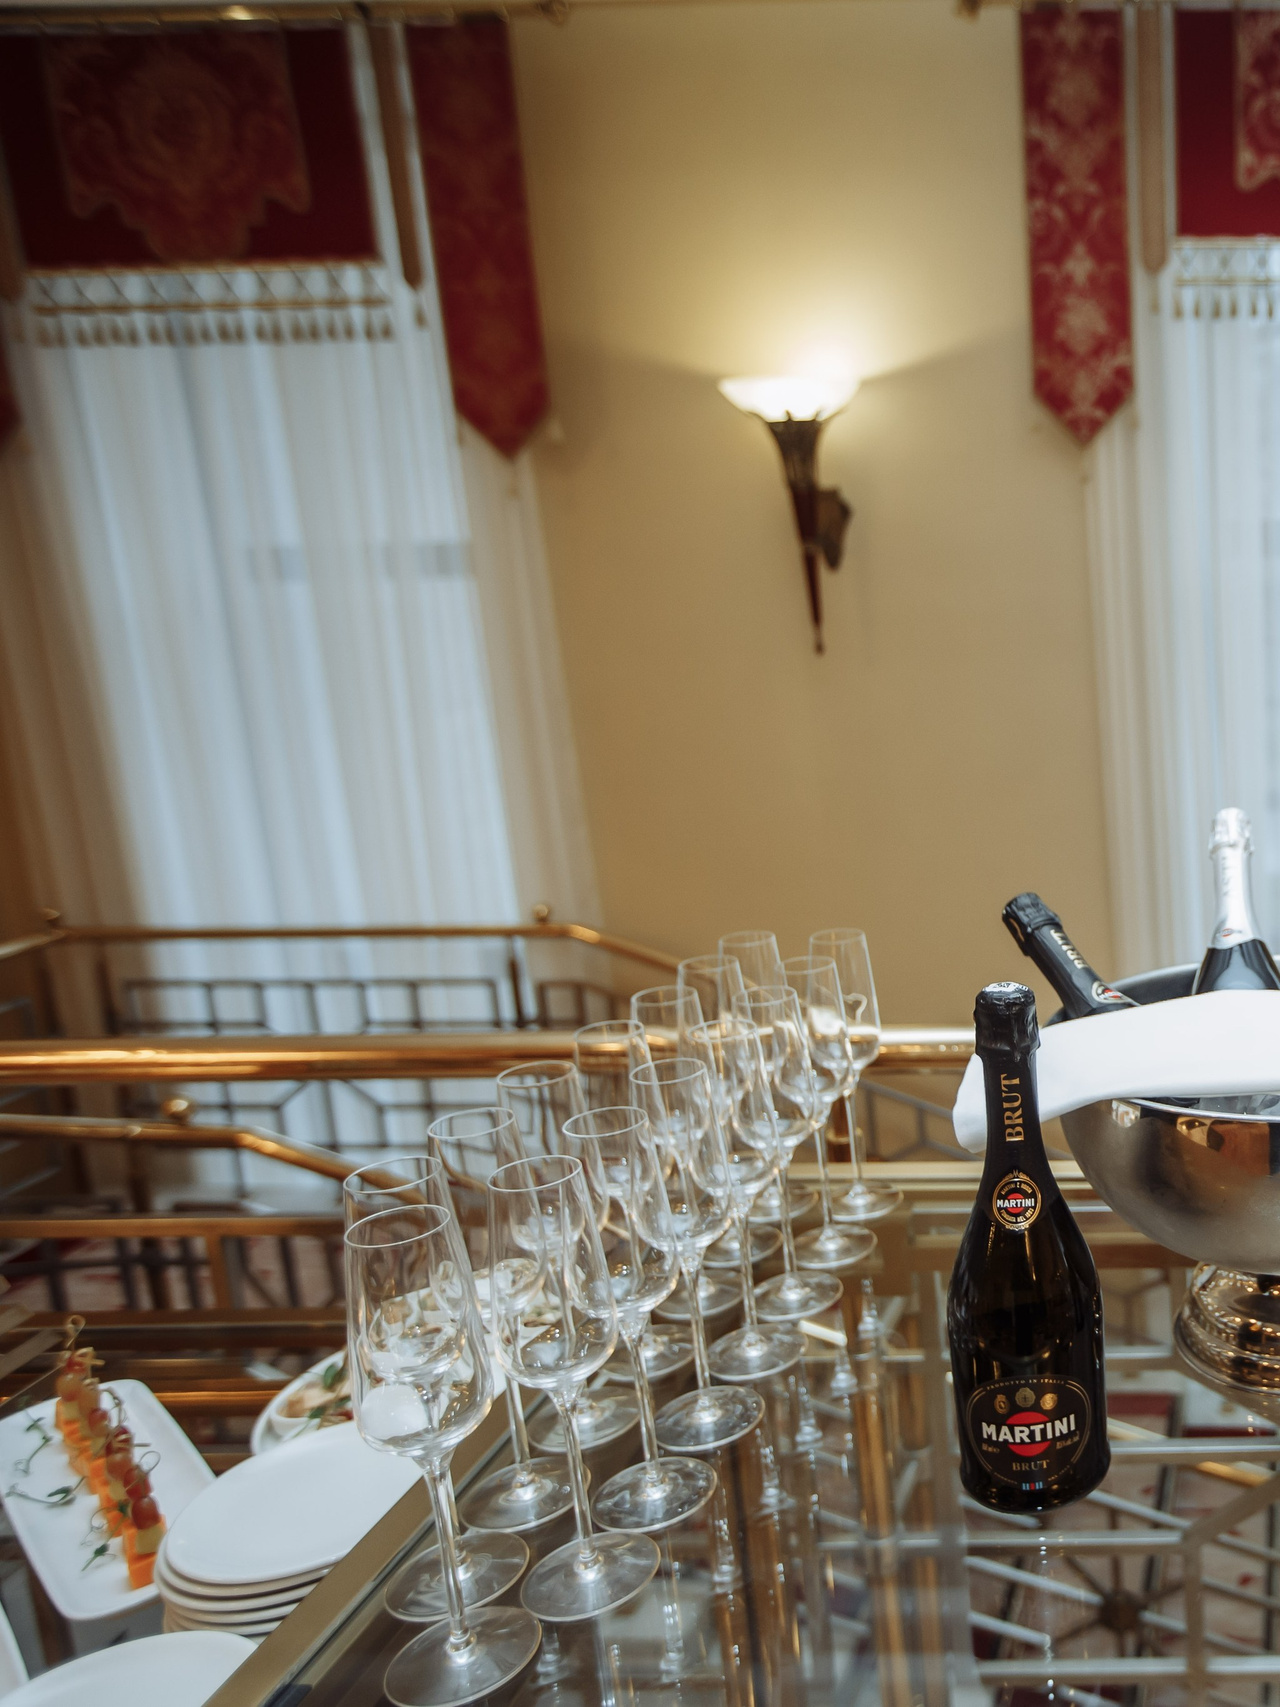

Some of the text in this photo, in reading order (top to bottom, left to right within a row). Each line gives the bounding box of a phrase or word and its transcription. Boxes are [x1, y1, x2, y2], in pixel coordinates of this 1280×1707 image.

[1000, 1073, 1025, 1142] BRUT
[997, 1198, 1035, 1208] MARTINI
[981, 1413, 1076, 1443] MARTINI
[1012, 1459, 1050, 1471] BRUT
